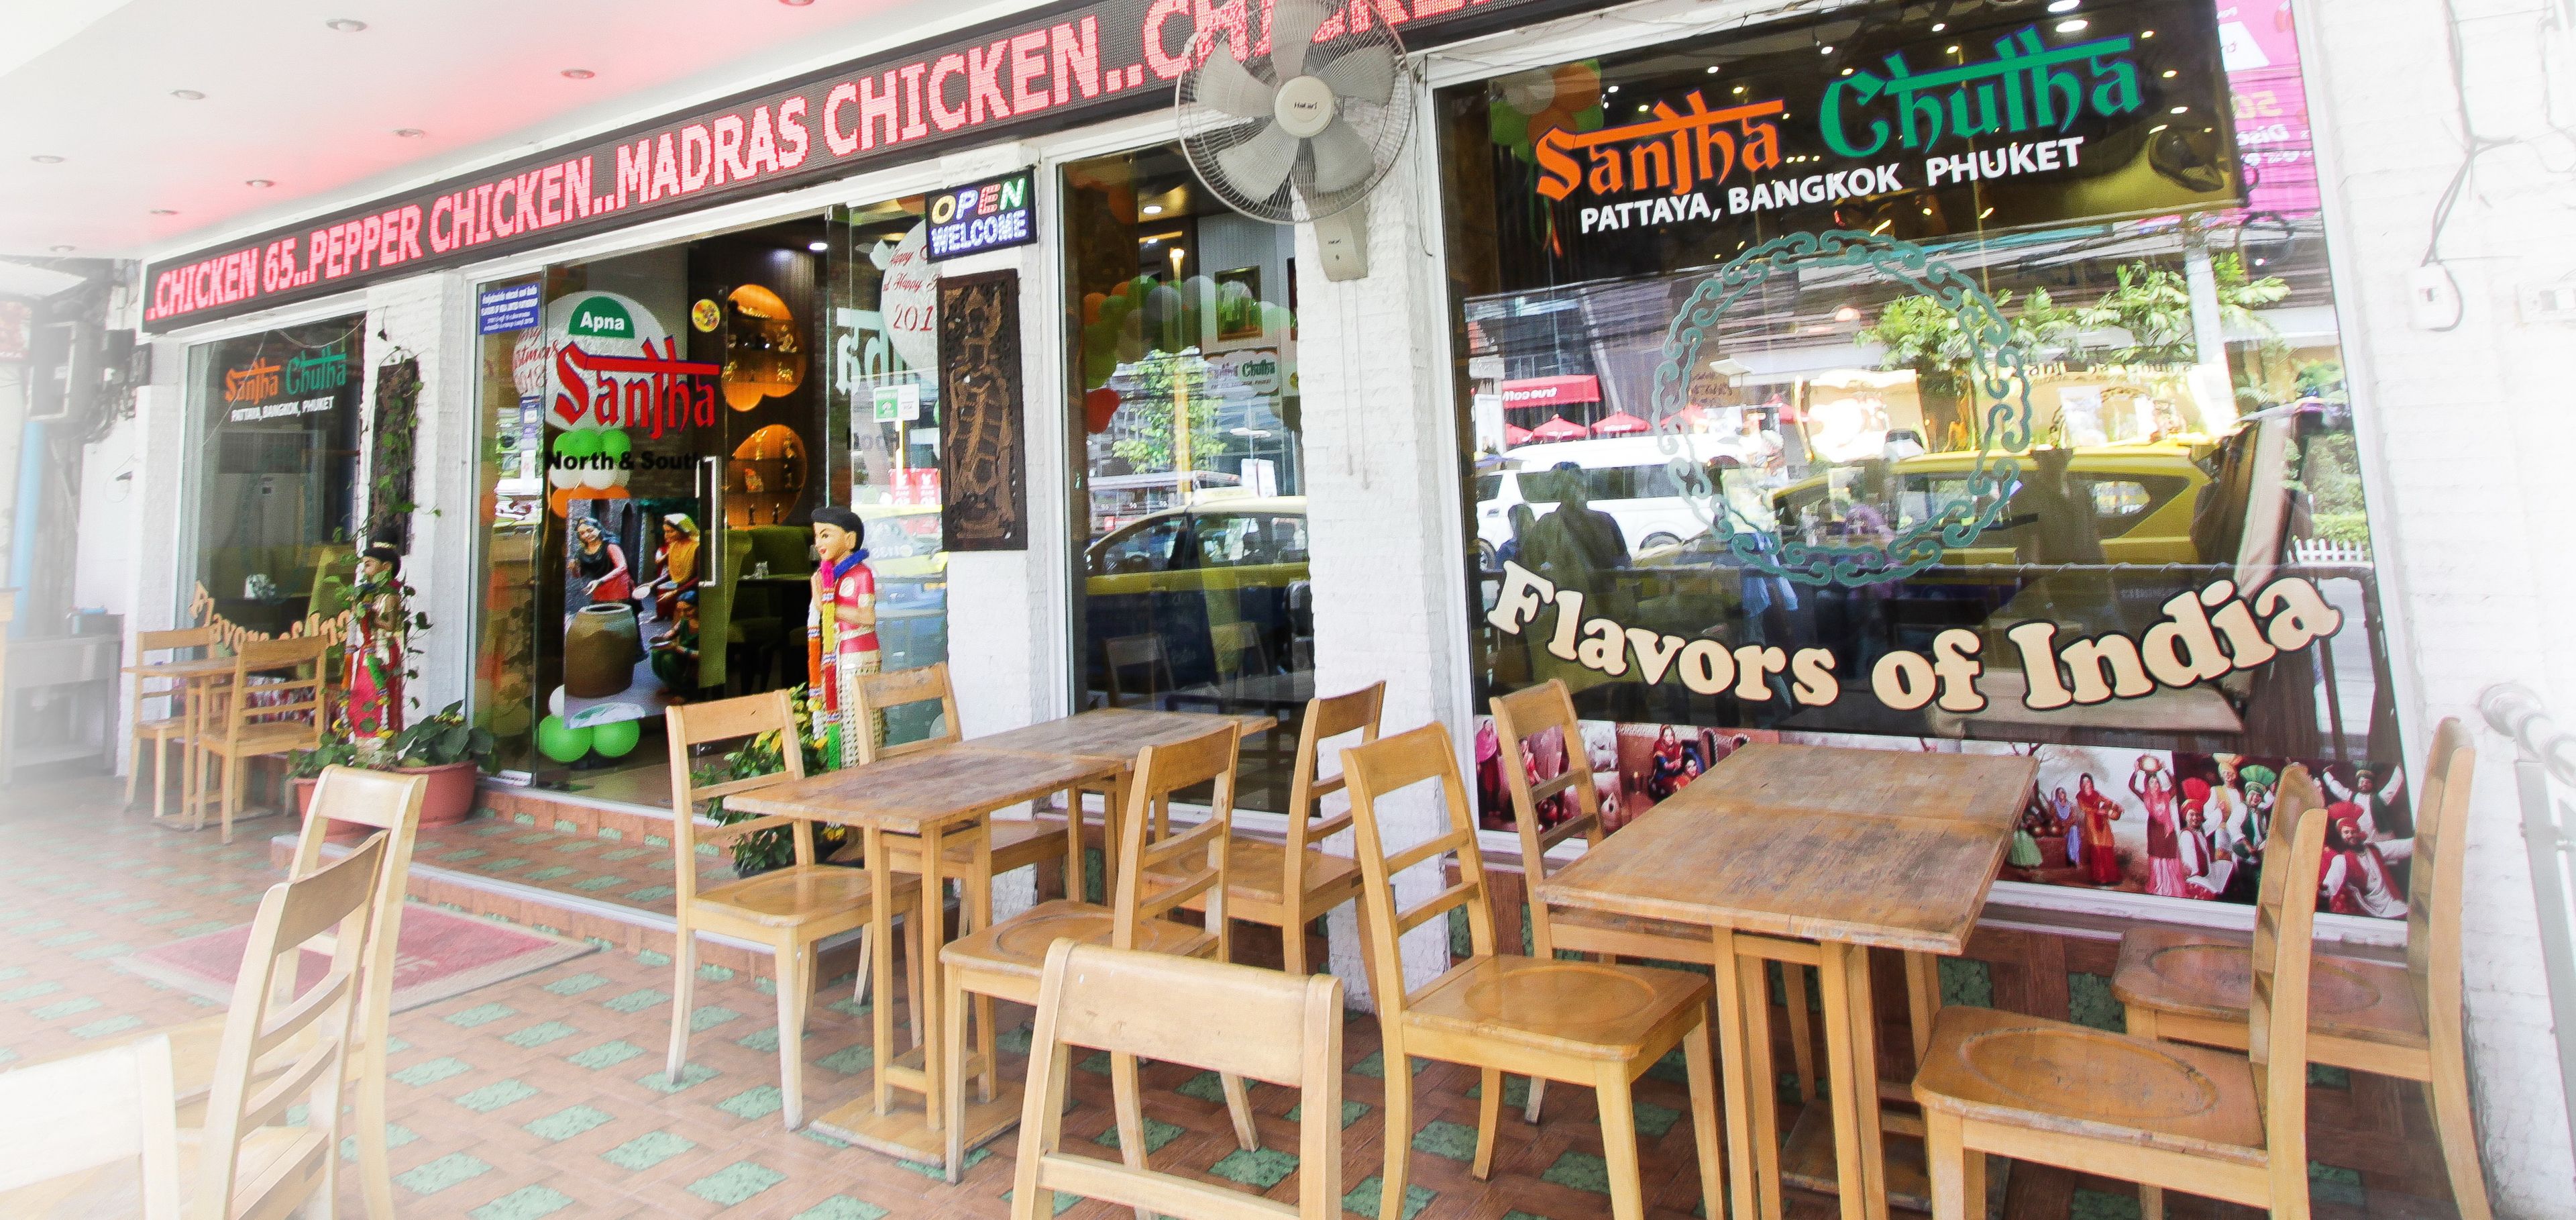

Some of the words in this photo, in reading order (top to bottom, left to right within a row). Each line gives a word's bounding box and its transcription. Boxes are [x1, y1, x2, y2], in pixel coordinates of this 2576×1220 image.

[1819, 23, 2145, 158] Chulha
[932, 178, 1025, 224] OPEN
[1580, 194, 1721, 234] PATTAYA,
[1729, 162, 1902, 215] BANGKOK
[1927, 136, 2084, 187] PHUKET
[931, 209, 1027, 255] WELCOME
[580, 311, 625, 333] Apna
[893, 303, 934, 332] 201
[302, 395, 335, 413] PHUKET
[545, 450, 614, 470] North
[619, 451, 635, 470] &
[1489, 560, 1839, 707] Flavors
[1872, 628, 1988, 711] of
[2010, 577, 2341, 710] India
